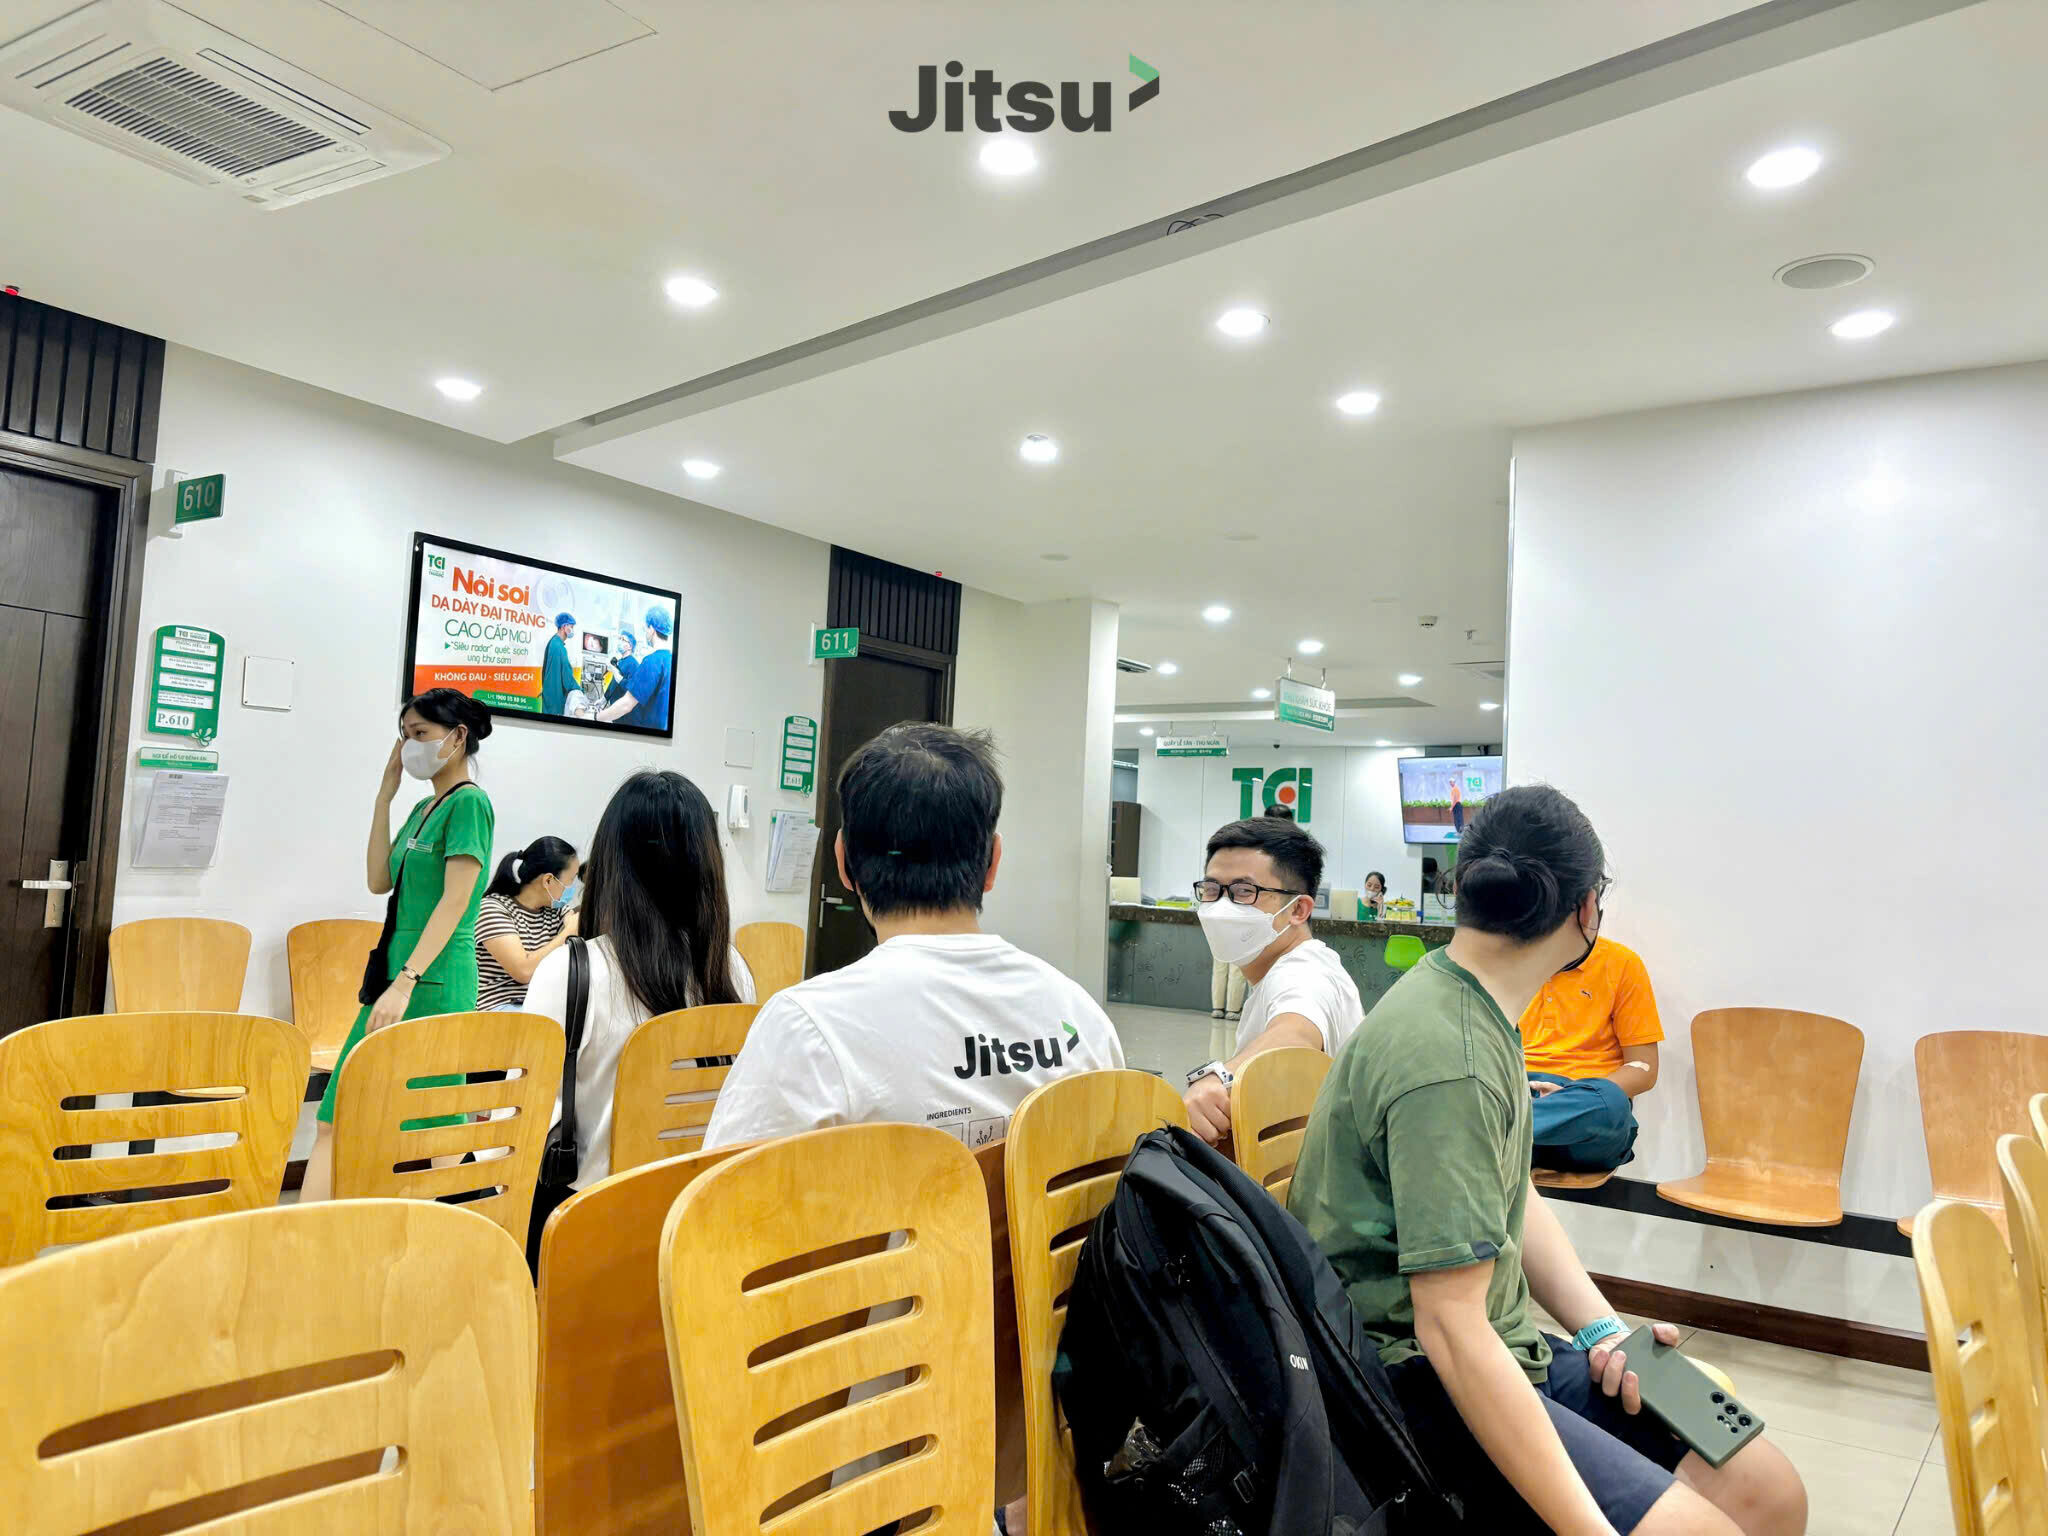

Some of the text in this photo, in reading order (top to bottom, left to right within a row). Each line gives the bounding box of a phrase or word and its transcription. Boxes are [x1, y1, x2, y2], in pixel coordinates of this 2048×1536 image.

[183, 481, 216, 510] 610
[452, 566, 530, 606] Nội soi
[431, 594, 546, 628] DẠ DÀY ĐẠI TRÀNG
[445, 619, 482, 638] CAO
[484, 624, 508, 640] CẤP
[821, 632, 850, 651] 611
[434, 671, 467, 681] KHÔNG
[469, 672, 487, 681] ĐAU
[158, 713, 189, 726] P.610
[1232, 767, 1312, 823] TCI
[953, 1033, 1063, 1079] Jitsu
[926, 1106, 972, 1121] INGREDIENTS
